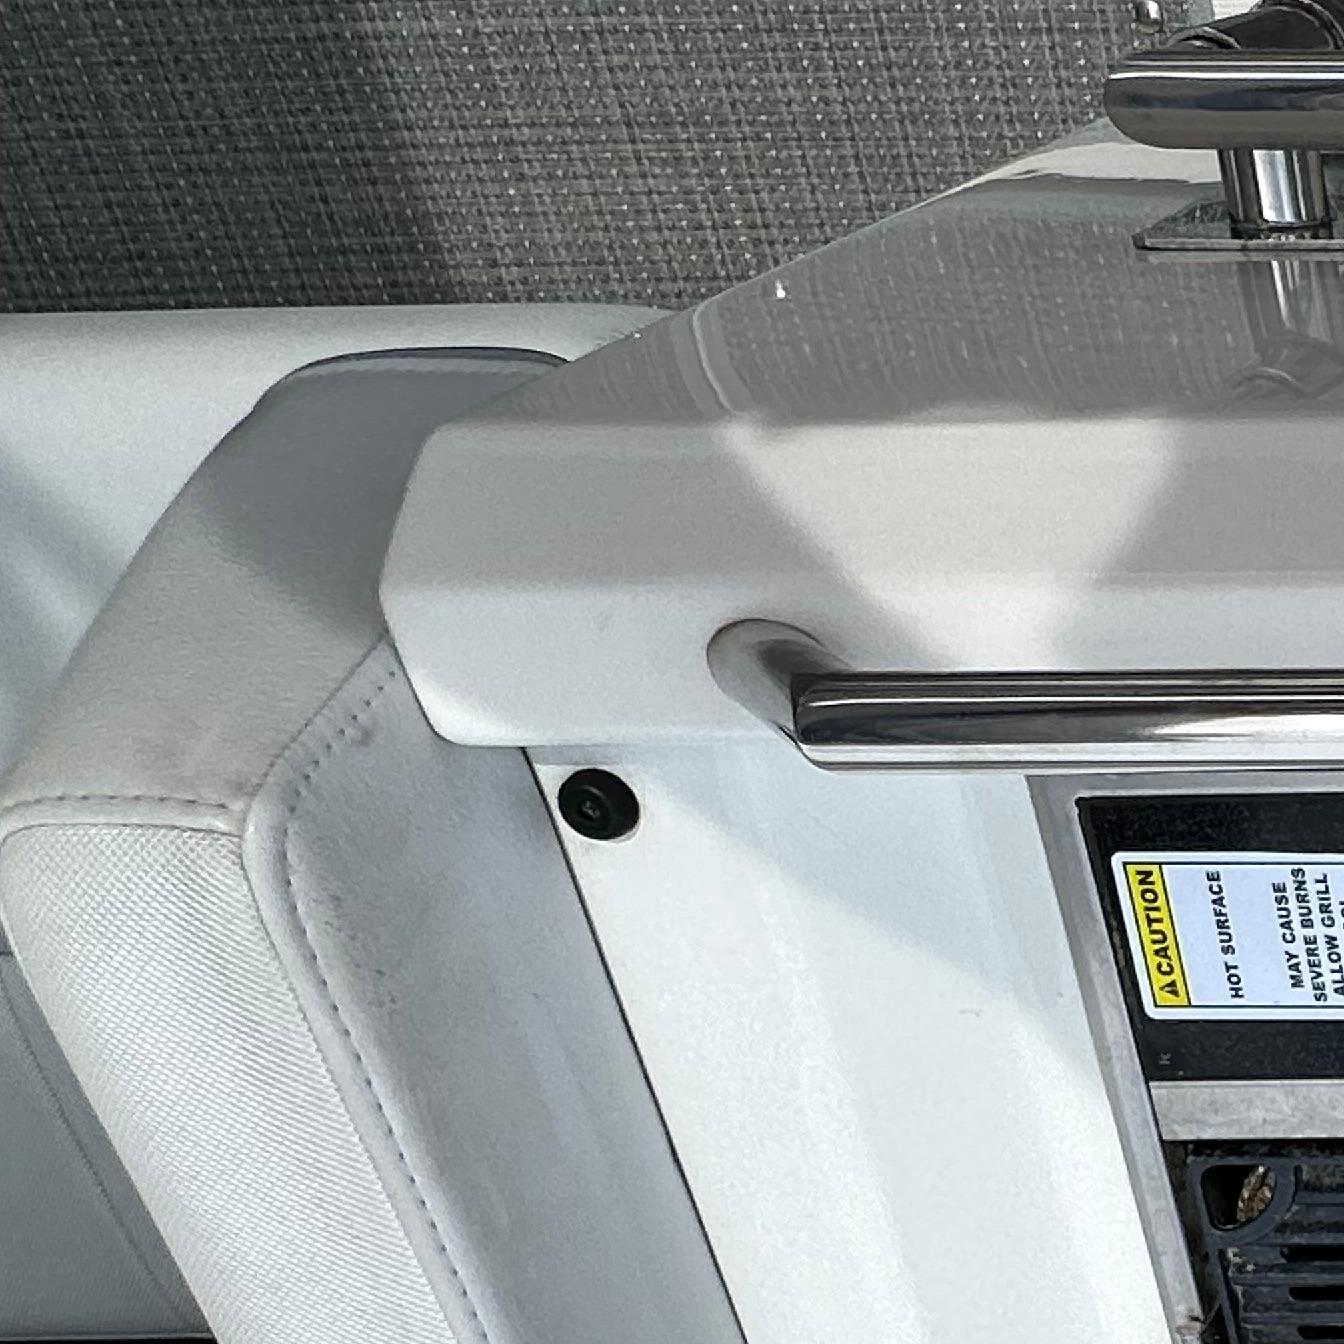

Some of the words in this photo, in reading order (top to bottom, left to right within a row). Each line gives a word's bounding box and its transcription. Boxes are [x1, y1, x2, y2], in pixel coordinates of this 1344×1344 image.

[1135, 869, 1175, 976] CAUTION
[1205, 870, 1236, 956] SURFACE
[1272, 881, 1297, 944] CAUSE
[1290, 867, 1315, 930] BURNS
[1314, 872, 1336, 928] GRILL
[1224, 961, 1245, 999] HOT
[1284, 950, 1305, 989] MAY
[1302, 934, 1328, 1003] SEVERE
